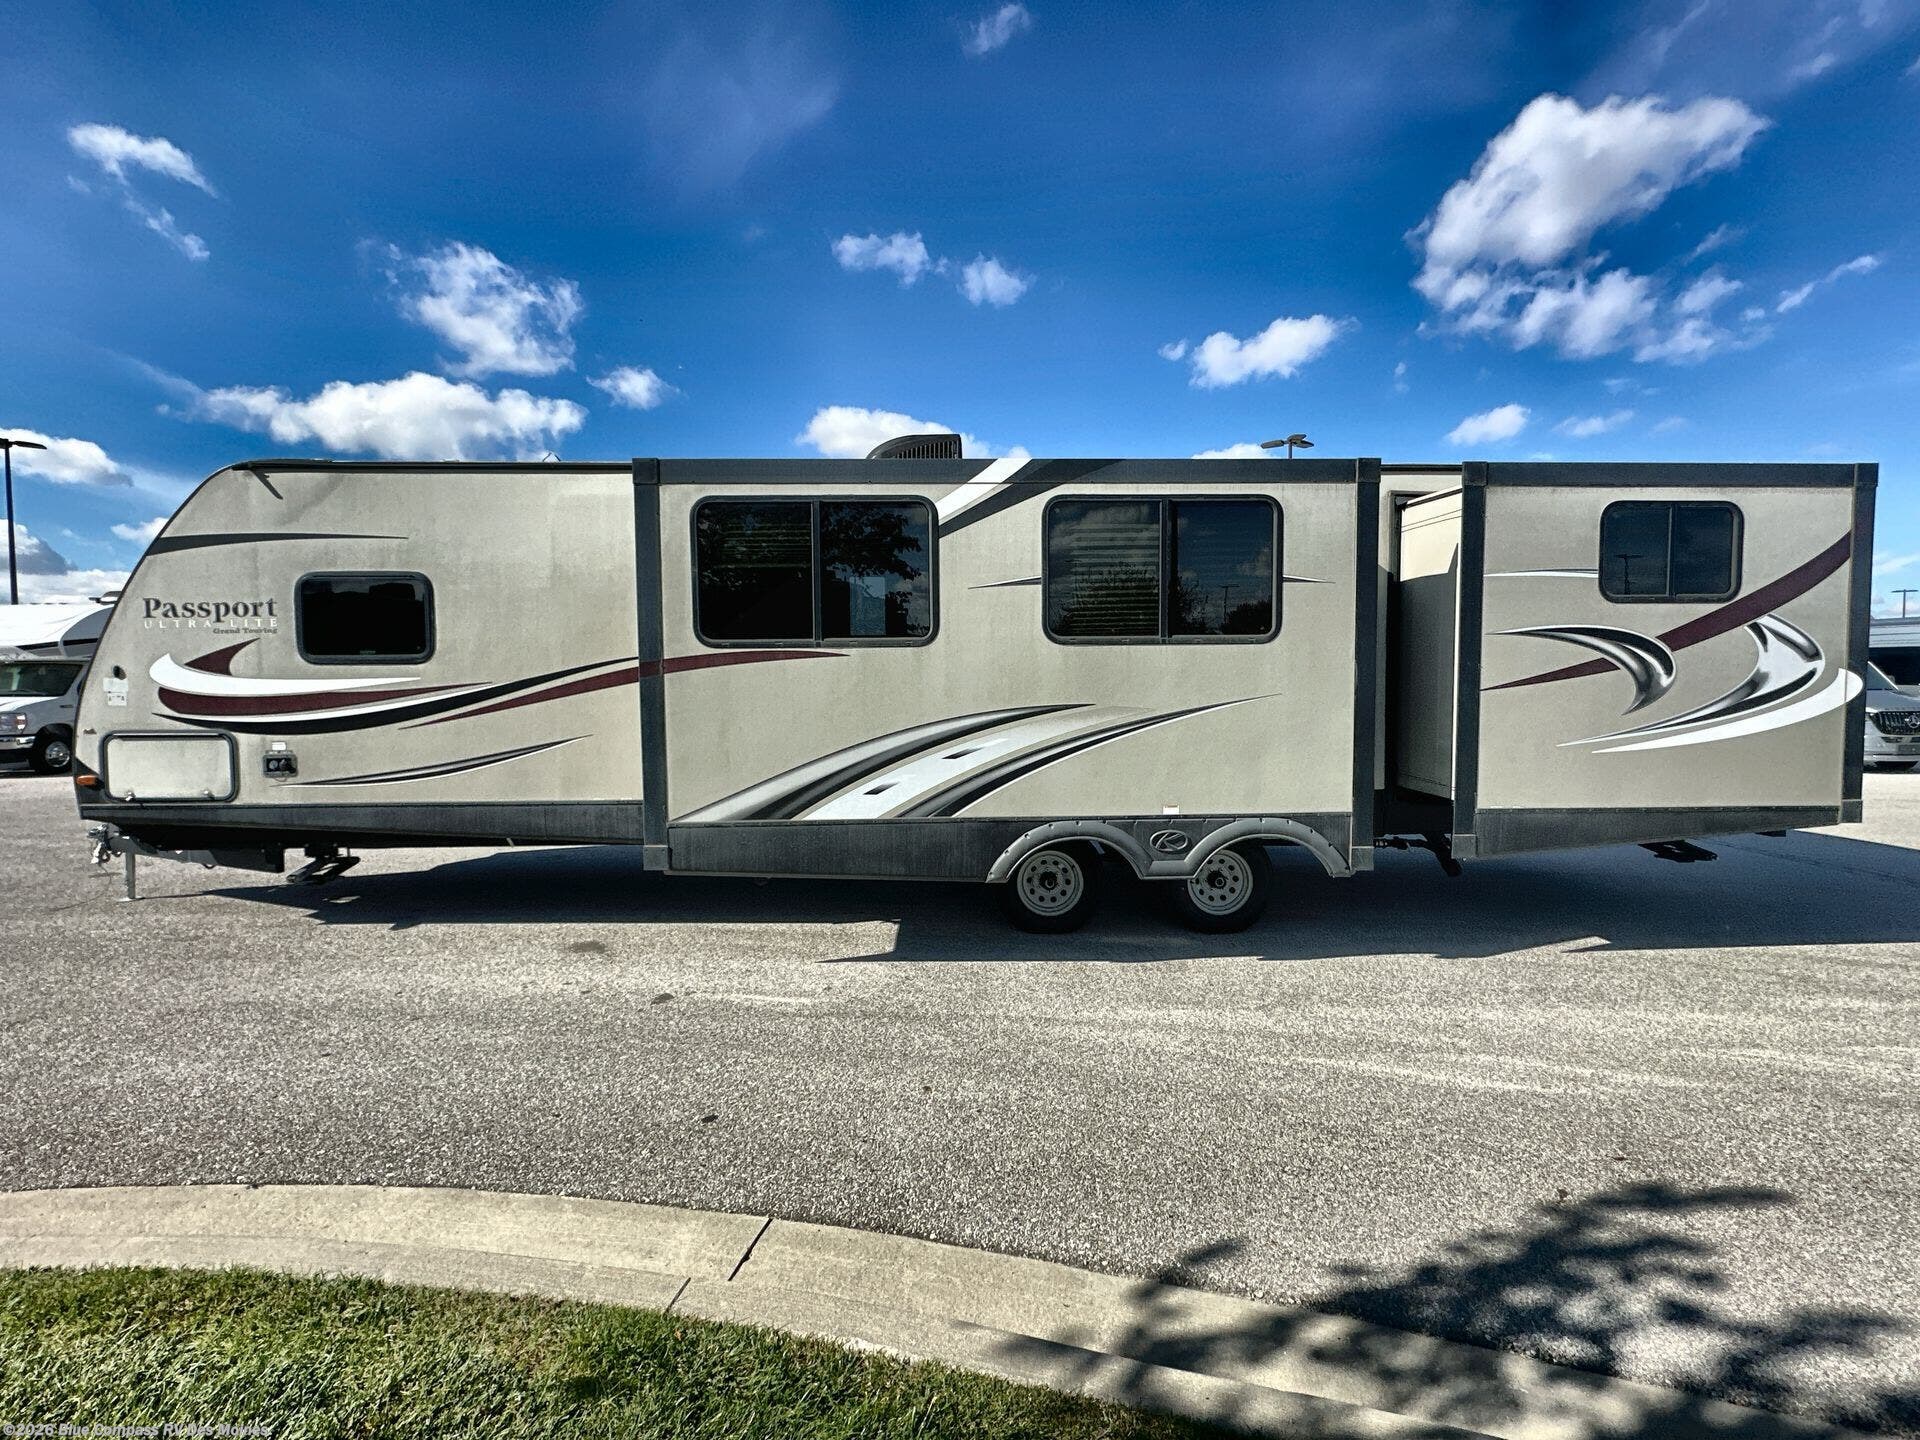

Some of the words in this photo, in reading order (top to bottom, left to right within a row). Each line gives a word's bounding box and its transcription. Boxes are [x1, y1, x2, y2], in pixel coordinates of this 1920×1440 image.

[143, 597, 277, 623] Passport
[144, 619, 212, 629] ULTRA
[230, 618, 278, 628] LITE
